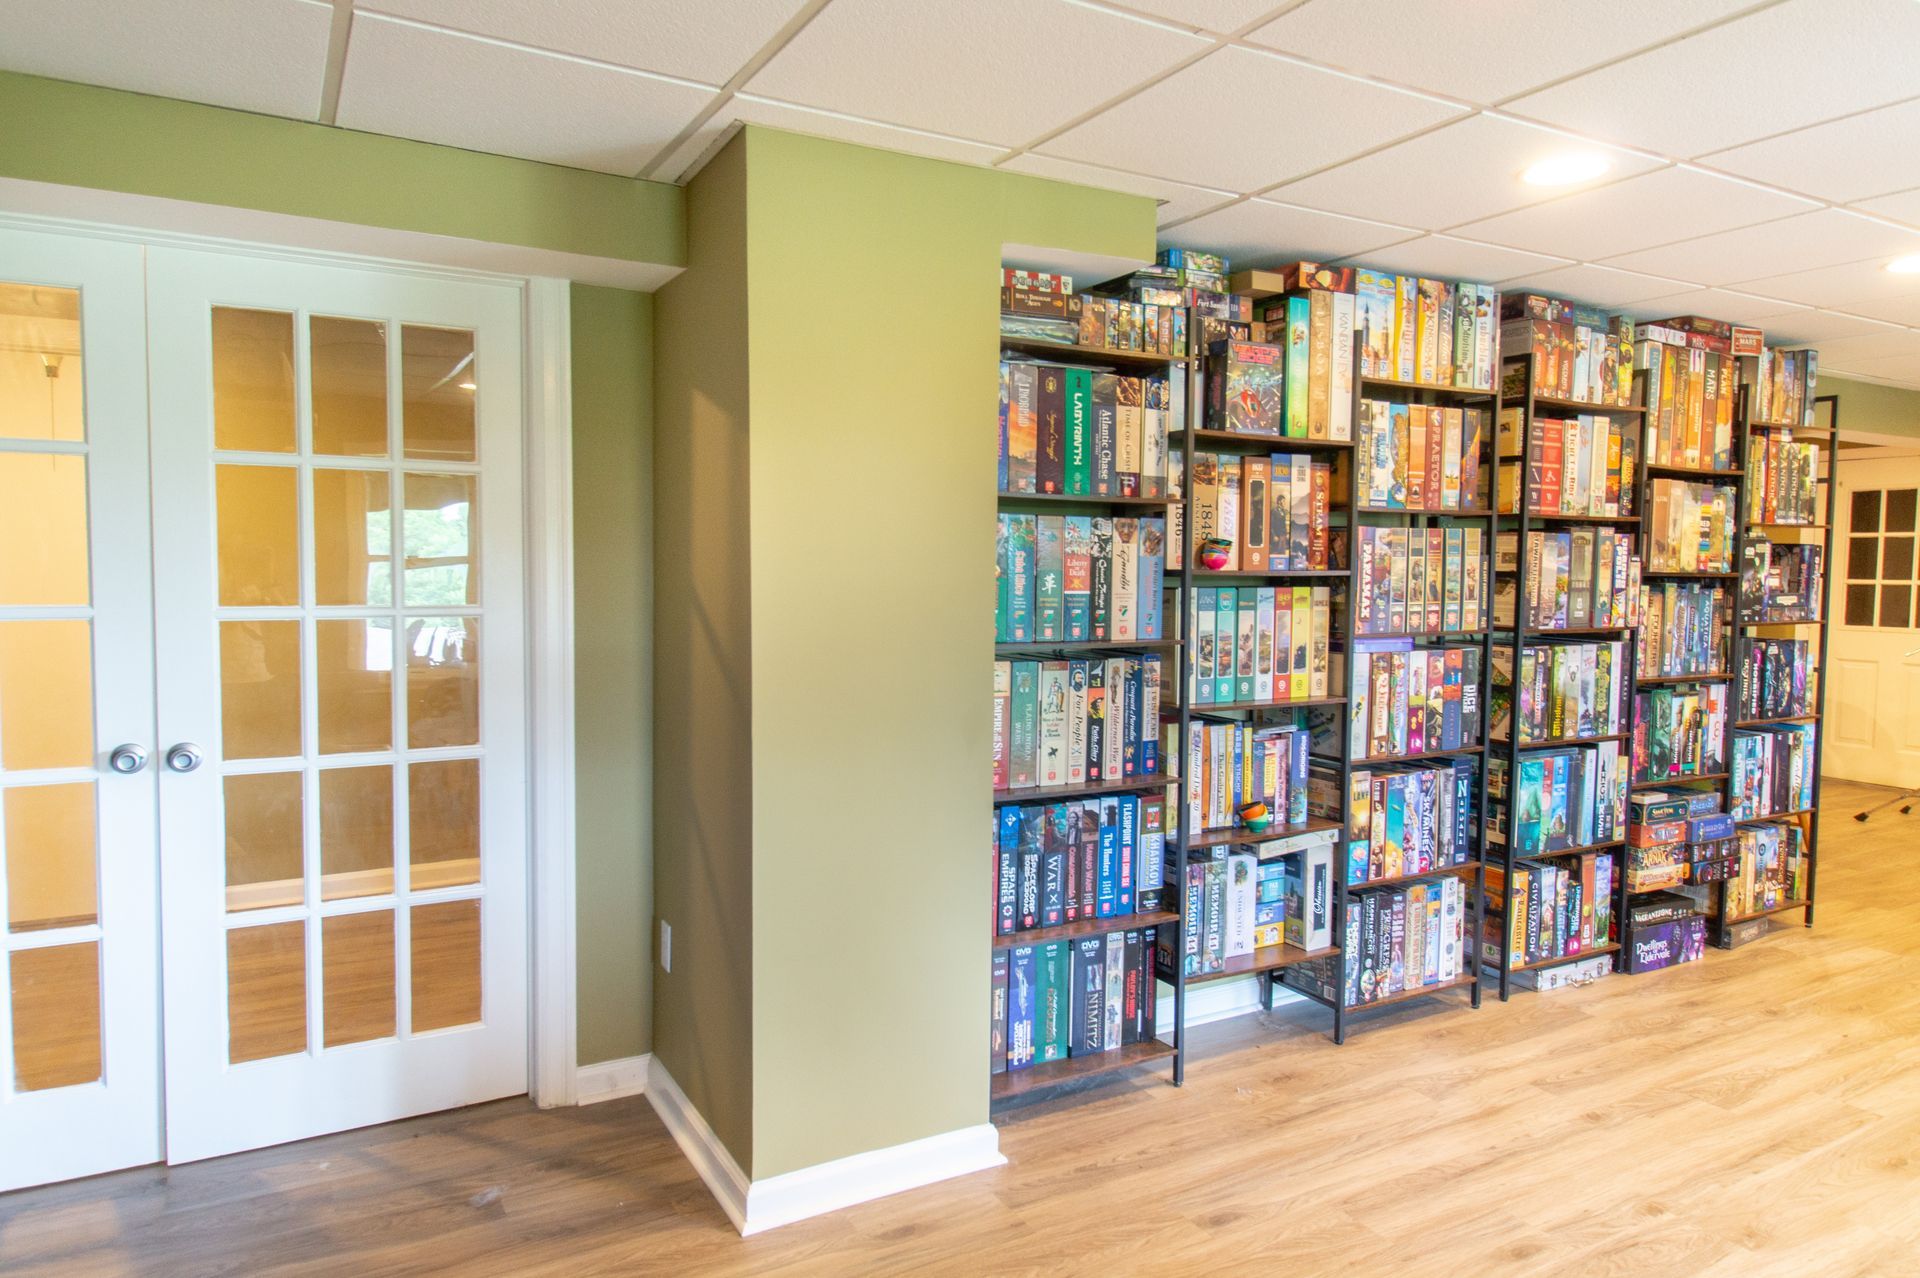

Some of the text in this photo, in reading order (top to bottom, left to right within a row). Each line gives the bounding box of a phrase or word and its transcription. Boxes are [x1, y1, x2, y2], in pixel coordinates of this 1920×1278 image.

[1338, 312, 1349, 359] KANBAN
[1479, 321, 1490, 364] suburbia
[1739, 337, 1757, 347] MARS
[1706, 369, 1716, 400] MARS
[1719, 368, 1727, 395] PLAN
[1073, 393, 1083, 465] LABYRINTH
[1101, 409, 1112, 480] Atlantic Chase
[1569, 433, 1577, 465] TICKET
[1430, 427, 1440, 490] PRAETOR
[1769, 459, 1777, 499] ANDOR
[1779, 459, 1788, 497] ANDOR
[1790, 459, 1798, 499] ANDOR
[1175, 505, 1184, 537] 1846
[1202, 503, 1213, 541] 1848
[1315, 490, 1325, 537] STEAM
[1067, 558, 1088, 567] Liberty
[1069, 568, 1086, 577] Death
[1117, 548, 1130, 591] Gandhi
[1360, 543, 1373, 618] PANAMAX
[1468, 684, 1476, 713] DICE
[1742, 659, 1750, 702] DESTINIES
[992, 698, 1004, 761] EMPIRE SUN
[1073, 694, 1084, 746] For People
[1090, 744, 1098, 762] Glory
[1193, 746, 1201, 778] Hundred
[1192, 781, 1201, 801] Days
[1122, 804, 1132, 845] FLASHPOINT
[1422, 796, 1431, 852] SKYMINES
[1048, 857, 1058, 891] WAR
[1085, 843, 1094, 892] NAVAJO WARS
[1103, 833, 1113, 877] The Hunters
[1122, 846, 1131, 862] SOUTH
[1149, 835, 1160, 886] KHARKOV
[1642, 847, 1669, 867] ARNAK
[1001, 854, 1009, 903] EMPIRES
[1121, 877, 1130, 888] SEA
[1187, 886, 1198, 936] MEMOIR
[1210, 882, 1220, 934] MEMOIR
[1367, 898, 1375, 954] HASPELKNECHT
[1516, 899, 1526, 952] Lancaster
[1529, 882, 1538, 952] CIVILIZATION
[1015, 947, 1032, 956] DVG
[1081, 940, 1099, 951] DVG
[1412, 906, 1421, 971] URBAN SPRAWL
[1636, 939, 1667, 955] Dwellings
[1640, 948, 1670, 964] Eldervale
[1087, 993, 1099, 1049] NIMITZ
